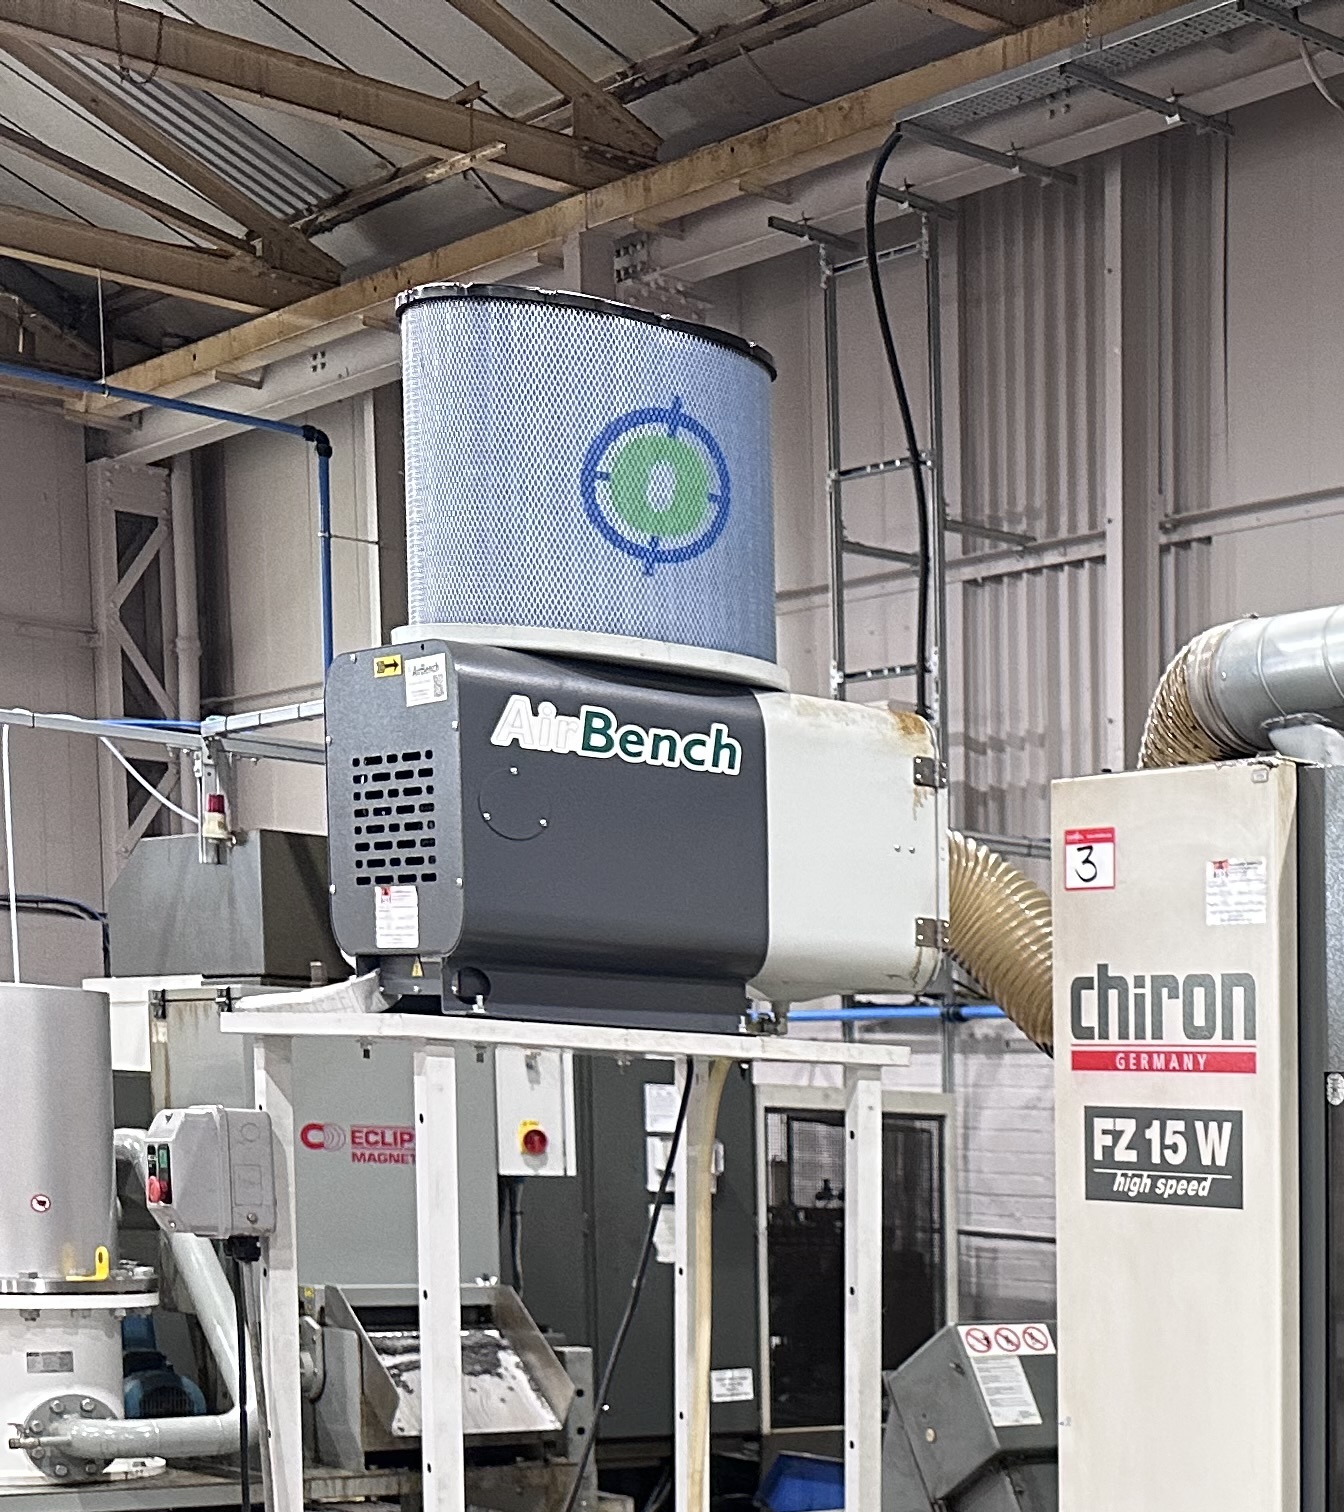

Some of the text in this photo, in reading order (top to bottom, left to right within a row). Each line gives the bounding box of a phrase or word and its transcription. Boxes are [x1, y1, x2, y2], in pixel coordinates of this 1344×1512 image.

[490, 694, 742, 775] AirBench
[1074, 844, 1098, 883] 3
[1070, 963, 1257, 1041] chiron
[1115, 1053, 1208, 1071] GERMANY
[351, 1128, 415, 1149] ECLIP
[1093, 1117, 1233, 1167] FZ 15 W
[1113, 1172, 1213, 1200] high speed
